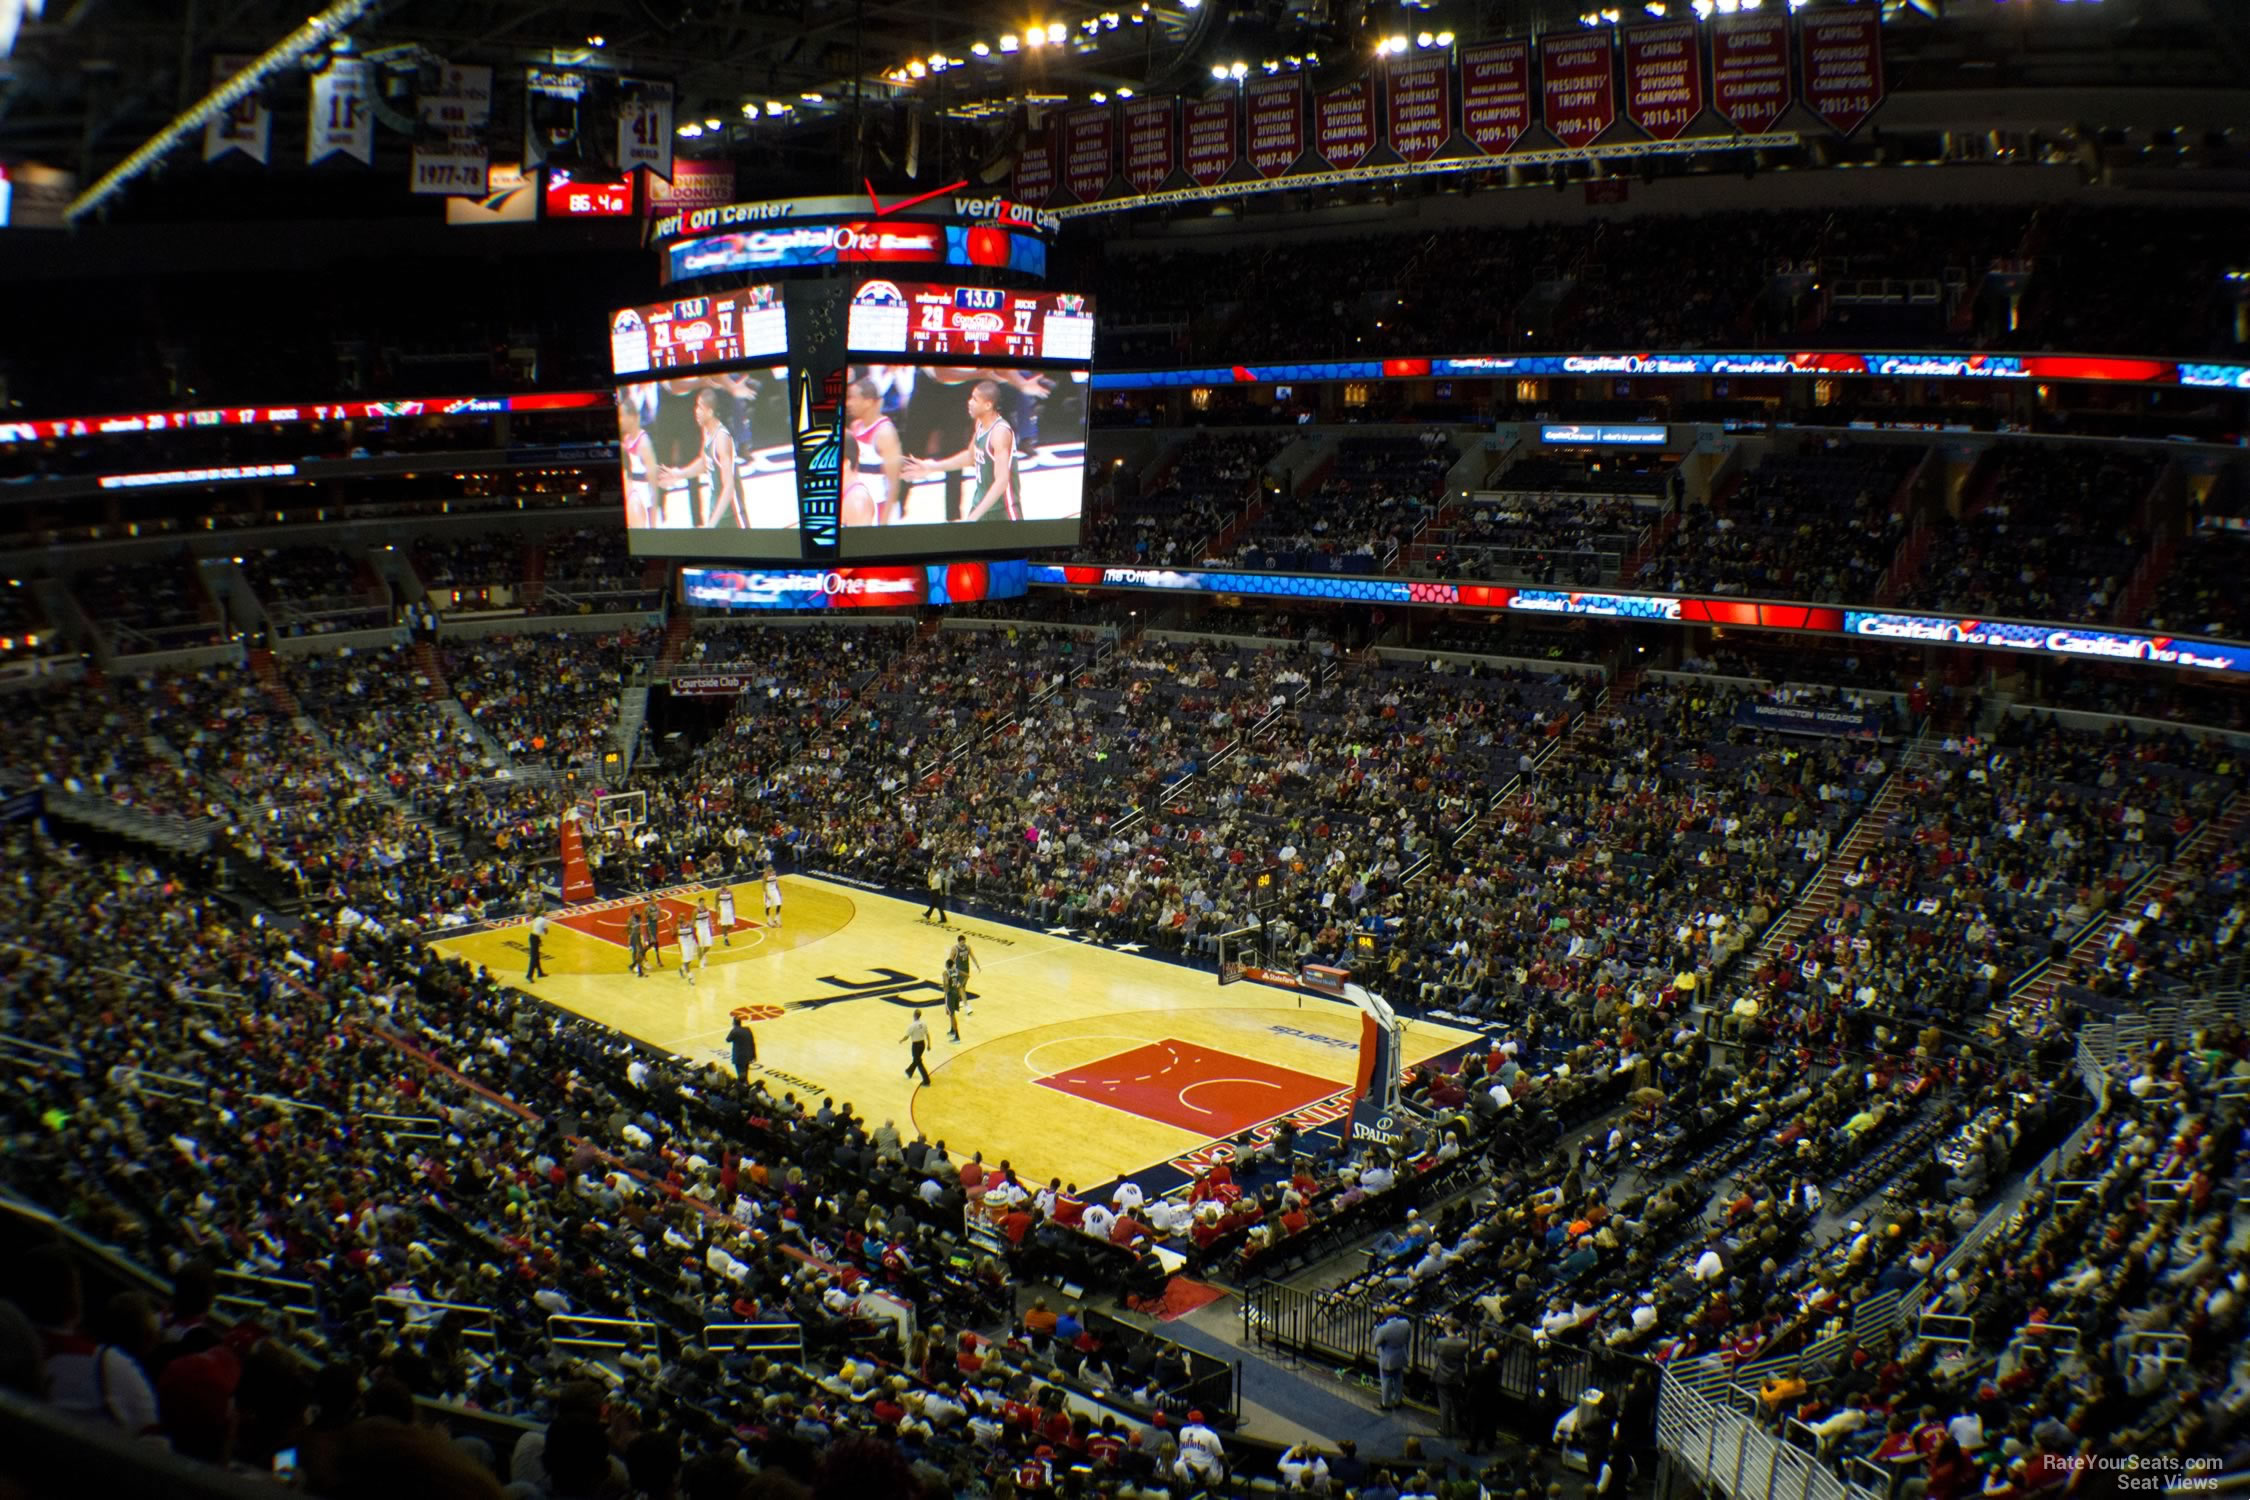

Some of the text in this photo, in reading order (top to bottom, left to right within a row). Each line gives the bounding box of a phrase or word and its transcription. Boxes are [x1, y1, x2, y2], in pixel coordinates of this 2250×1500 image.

[1629, 25, 1693, 43] WASHINGTON
[1727, 32, 1773, 49] CAPITALS
[1816, 26, 1864, 41] CAPITALS
[1545, 35, 1607, 53] WASHINGTON
[1640, 41, 1683, 58] CAPITALS
[1465, 46, 1524, 64] WASHINGTON
[1557, 51, 1597, 67] CAPITALS
[1812, 45, 1870, 62] SOUTHEAST
[1390, 57, 1445, 75] WASHINGTON
[1475, 62, 1514, 77] CAPITALS
[1635, 59, 1688, 78] SOUTHEAST
[1818, 61, 1866, 76] DIVISION
[1250, 79, 1299, 95] WASHINGTON
[1400, 72, 1436, 88] CAPITALS
[1641, 75, 1685, 91] DIVISION
[1812, 75, 1873, 91] CHAMPIONS
[1395, 88, 1440, 105] SOUTHEAST
[1723, 80, 1782, 97] CHAMPIONS
[1258, 92, 1291, 107] CAPITALS
[1558, 91, 1597, 108] TROPHY
[1635, 88, 1691, 106] CHAMPIONS
[1820, 95, 1870, 113] 2012-13
[329, 96, 354, 128] 11
[1126, 100, 1170, 115] WASHINGTON
[1194, 102, 1225, 116] CAPITALS
[1322, 99, 1366, 115] SOUTHEAST
[1400, 104, 1436, 118] DIVISION
[1471, 106, 1521, 123] CHAMPIONS
[1730, 101, 1777, 120] 2010-11
[1253, 109, 1294, 125] SOUTHEAST
[1327, 112, 1363, 127] DIVISION
[1642, 108, 1688, 127] 2010-11
[632, 112, 659, 145] 41
[1189, 119, 1228, 134] SOUTHEAST
[1257, 122, 1291, 136] DIVISION
[1322, 125, 1368, 141] CHAMPIONS
[1395, 118, 1441, 135] CHAMPIONS
[1476, 125, 1518, 143] 2009-10
[1556, 117, 1601, 135] 2009-10
[1130, 128, 1166, 142] SOUTHEAST
[1193, 131, 1225, 145] DIVISION
[1253, 134, 1295, 150] CHAMPIONS
[1133, 140, 1163, 154] DIVISION
[1188, 142, 1229, 158] CHAMPIONS
[1327, 143, 1365, 160] 2008-09
[1399, 136, 1438, 152] 2009-10
[1129, 152, 1167, 167] CHAMPIONS
[1256, 151, 1293, 167] 2007-08
[419, 164, 480, 186] 1977-78
[1070, 161, 1106, 176] CHAMPIONS
[1192, 160, 1226, 176] 2000-01
[673, 187, 729, 200] DONUTS
[656, 203, 793, 236] verizon Center
[955, 195, 1033, 228] verizon
[964, 289, 996, 308] 13.0
[1014, 299, 1037, 310] BUCKS
[922, 306, 944, 329] 29
[1014, 311, 1032, 332] 17
[913, 331, 930, 340] FOULS
[964, 332, 990, 342] QUARTER
[678, 677, 739, 688] Courtside Club
[1755, 705, 1863, 724] WASHINGTON WIZARDS
[963, 930, 1015, 947] Verizon
[764, 1069, 825, 1096] Verizon
